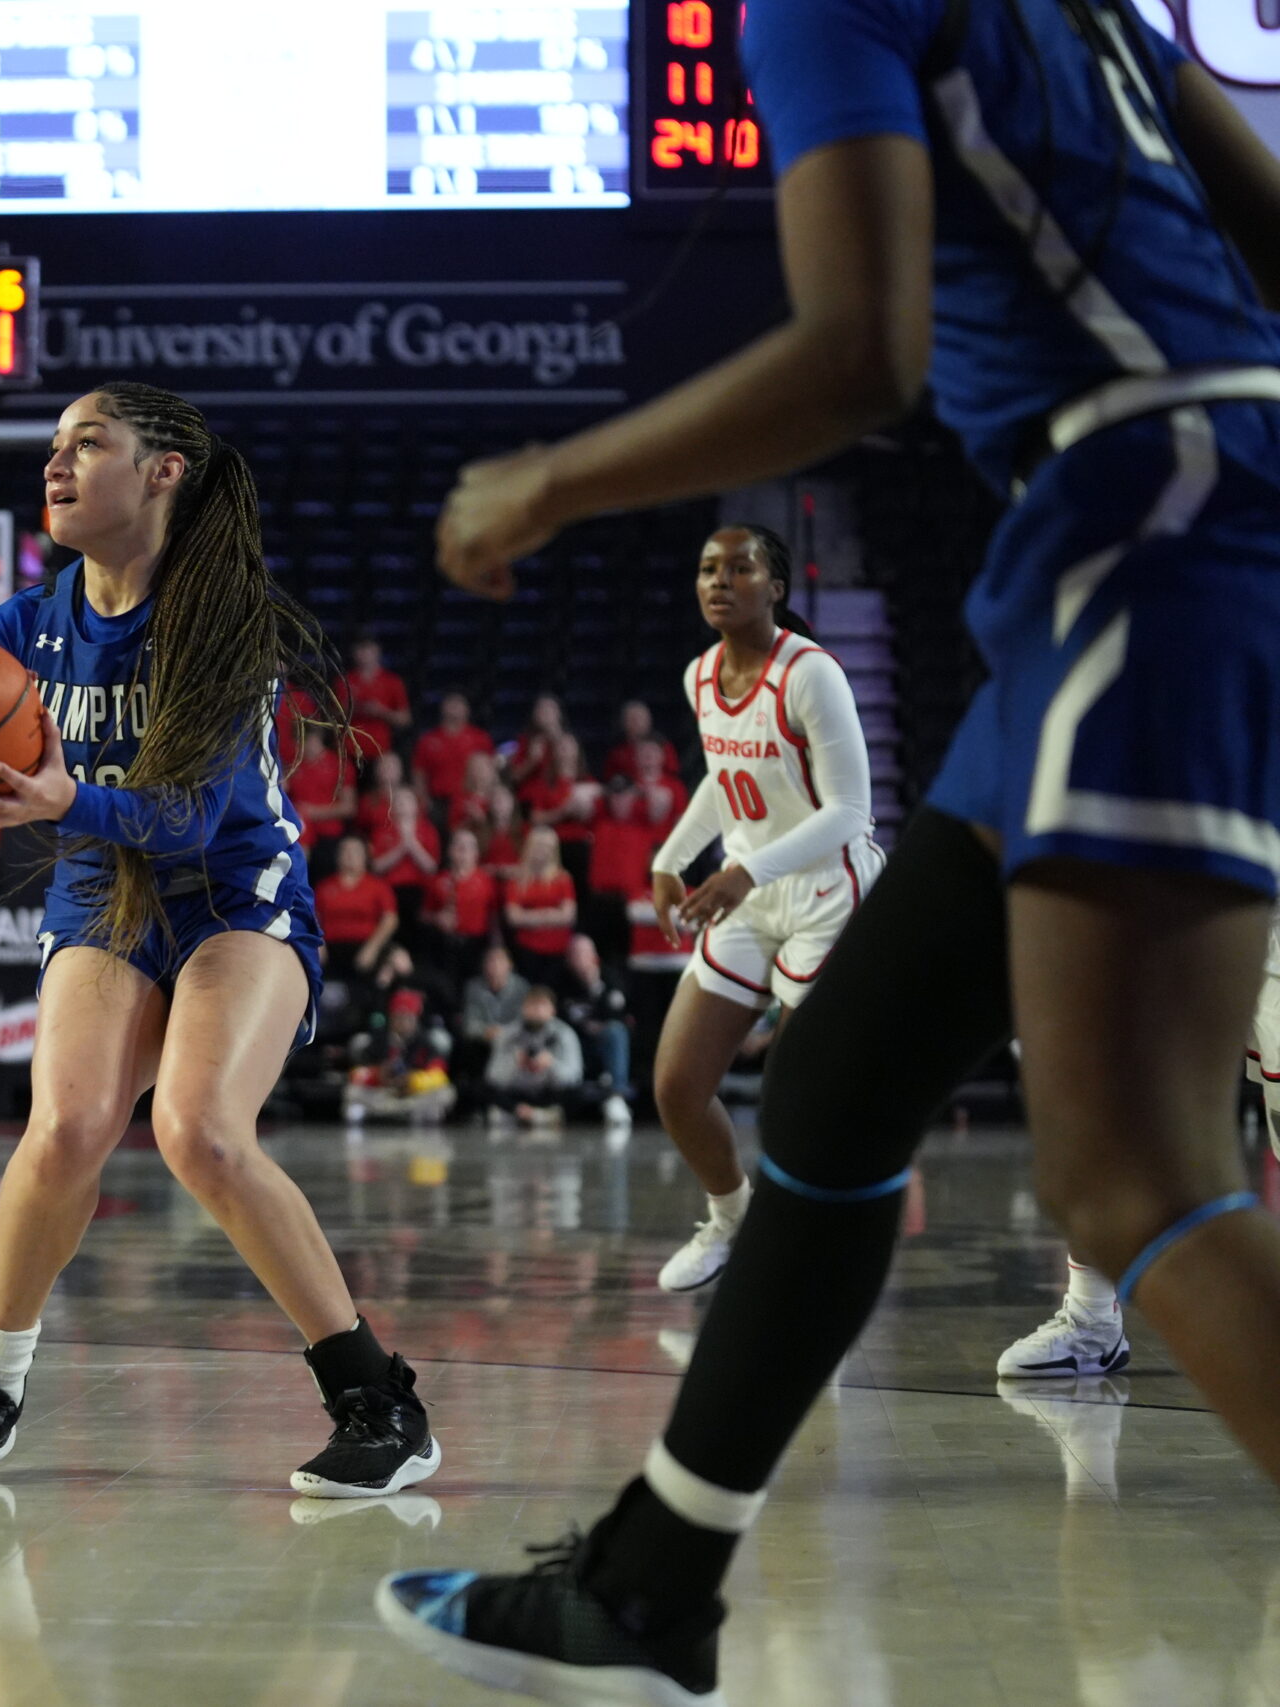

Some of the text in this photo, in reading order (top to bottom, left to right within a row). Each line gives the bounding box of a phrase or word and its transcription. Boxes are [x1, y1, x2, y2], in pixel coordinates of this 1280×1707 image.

[39, 302, 625, 387] University of Georgia
[717, 768, 769, 822] 10
